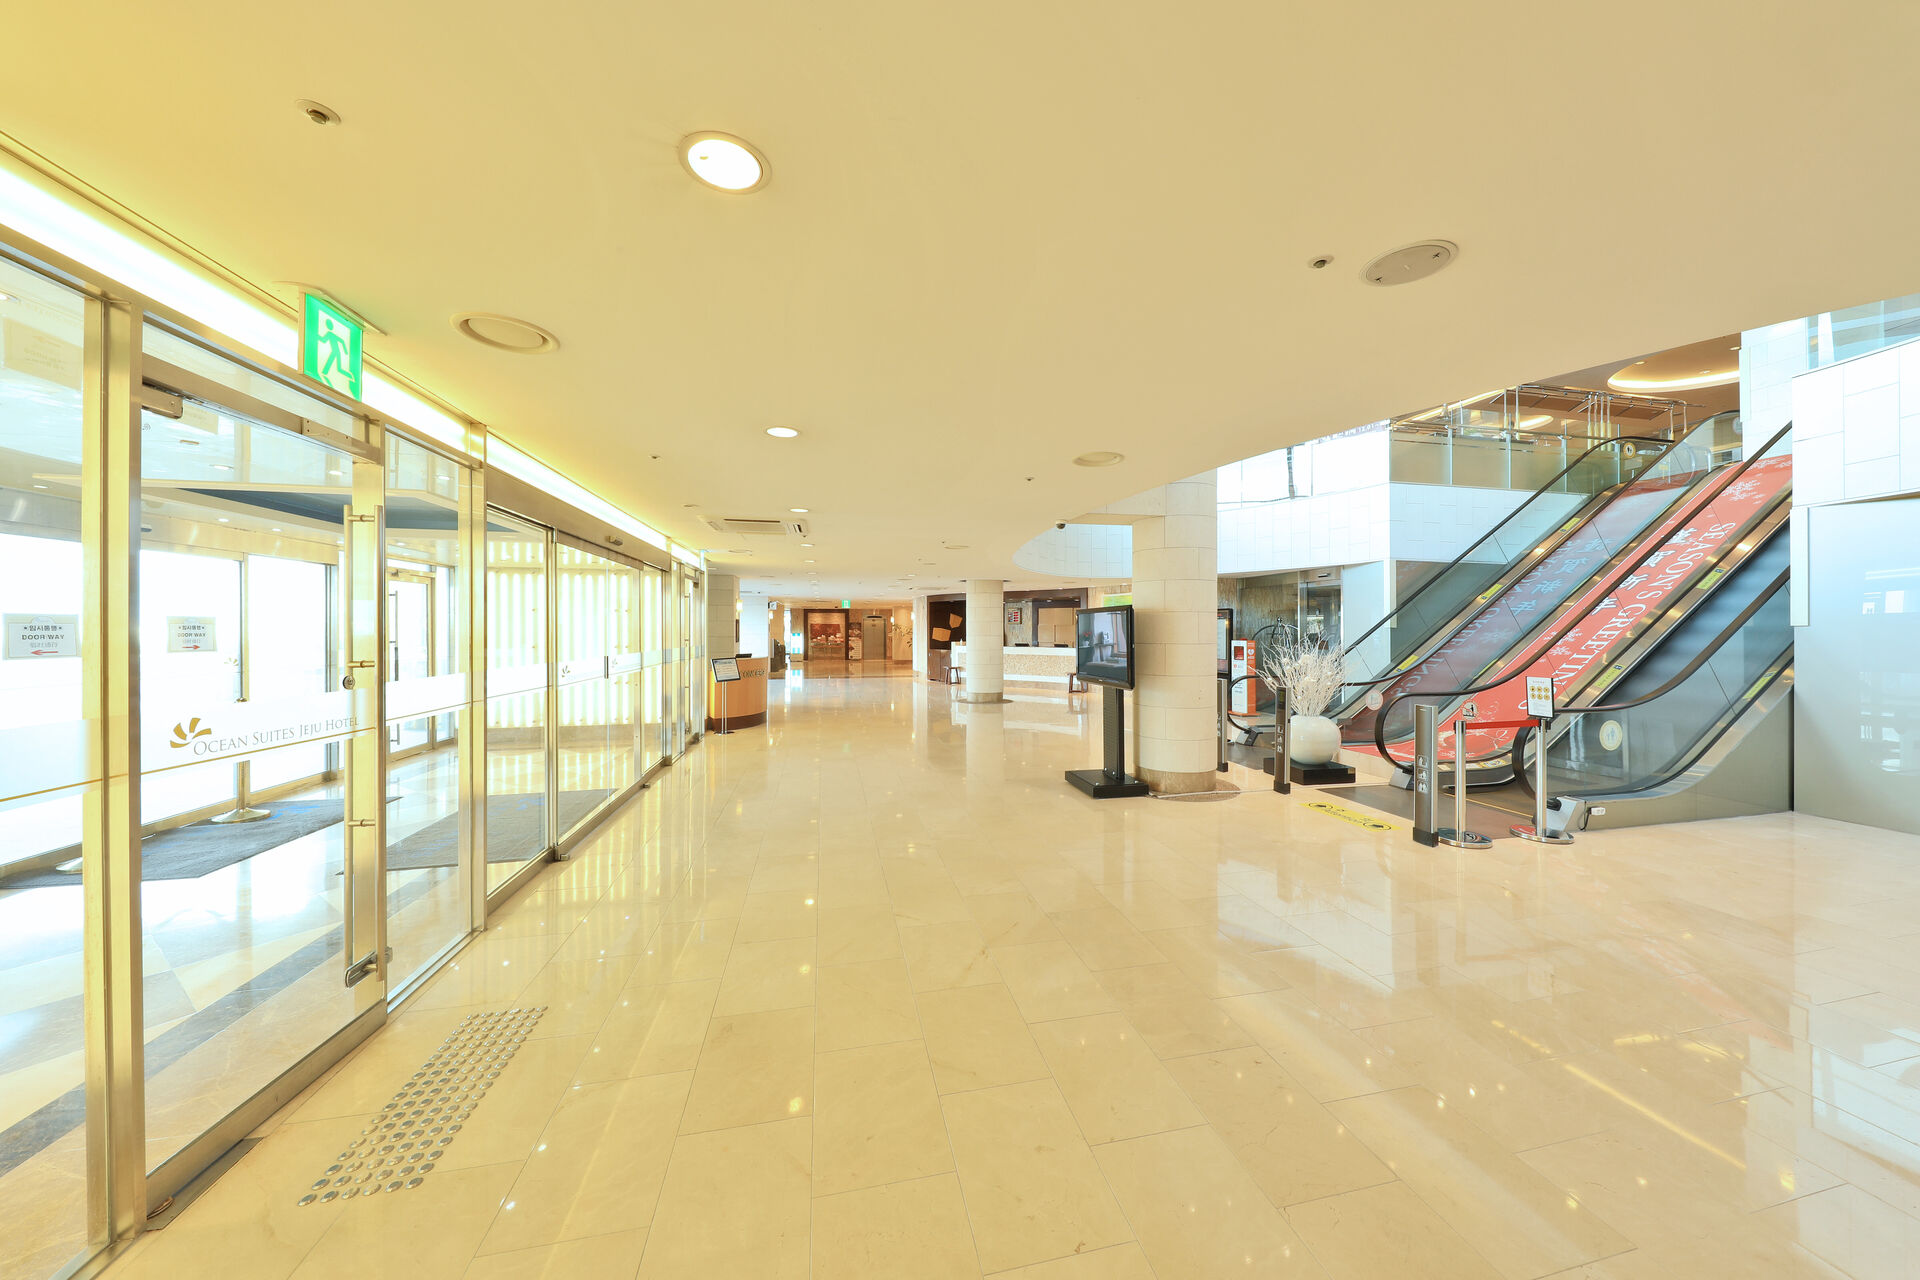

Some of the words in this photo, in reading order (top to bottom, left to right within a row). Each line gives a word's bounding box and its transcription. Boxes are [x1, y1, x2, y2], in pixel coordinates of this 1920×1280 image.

[1636, 522, 1737, 600] SEASON'S
[1518, 603, 1646, 710] GREETIN
[193, 735, 248, 756] OCEAN
[252, 727, 295, 746] SUITES
[299, 722, 322, 738] JEJU
[325, 716, 359, 732] HOTEL
